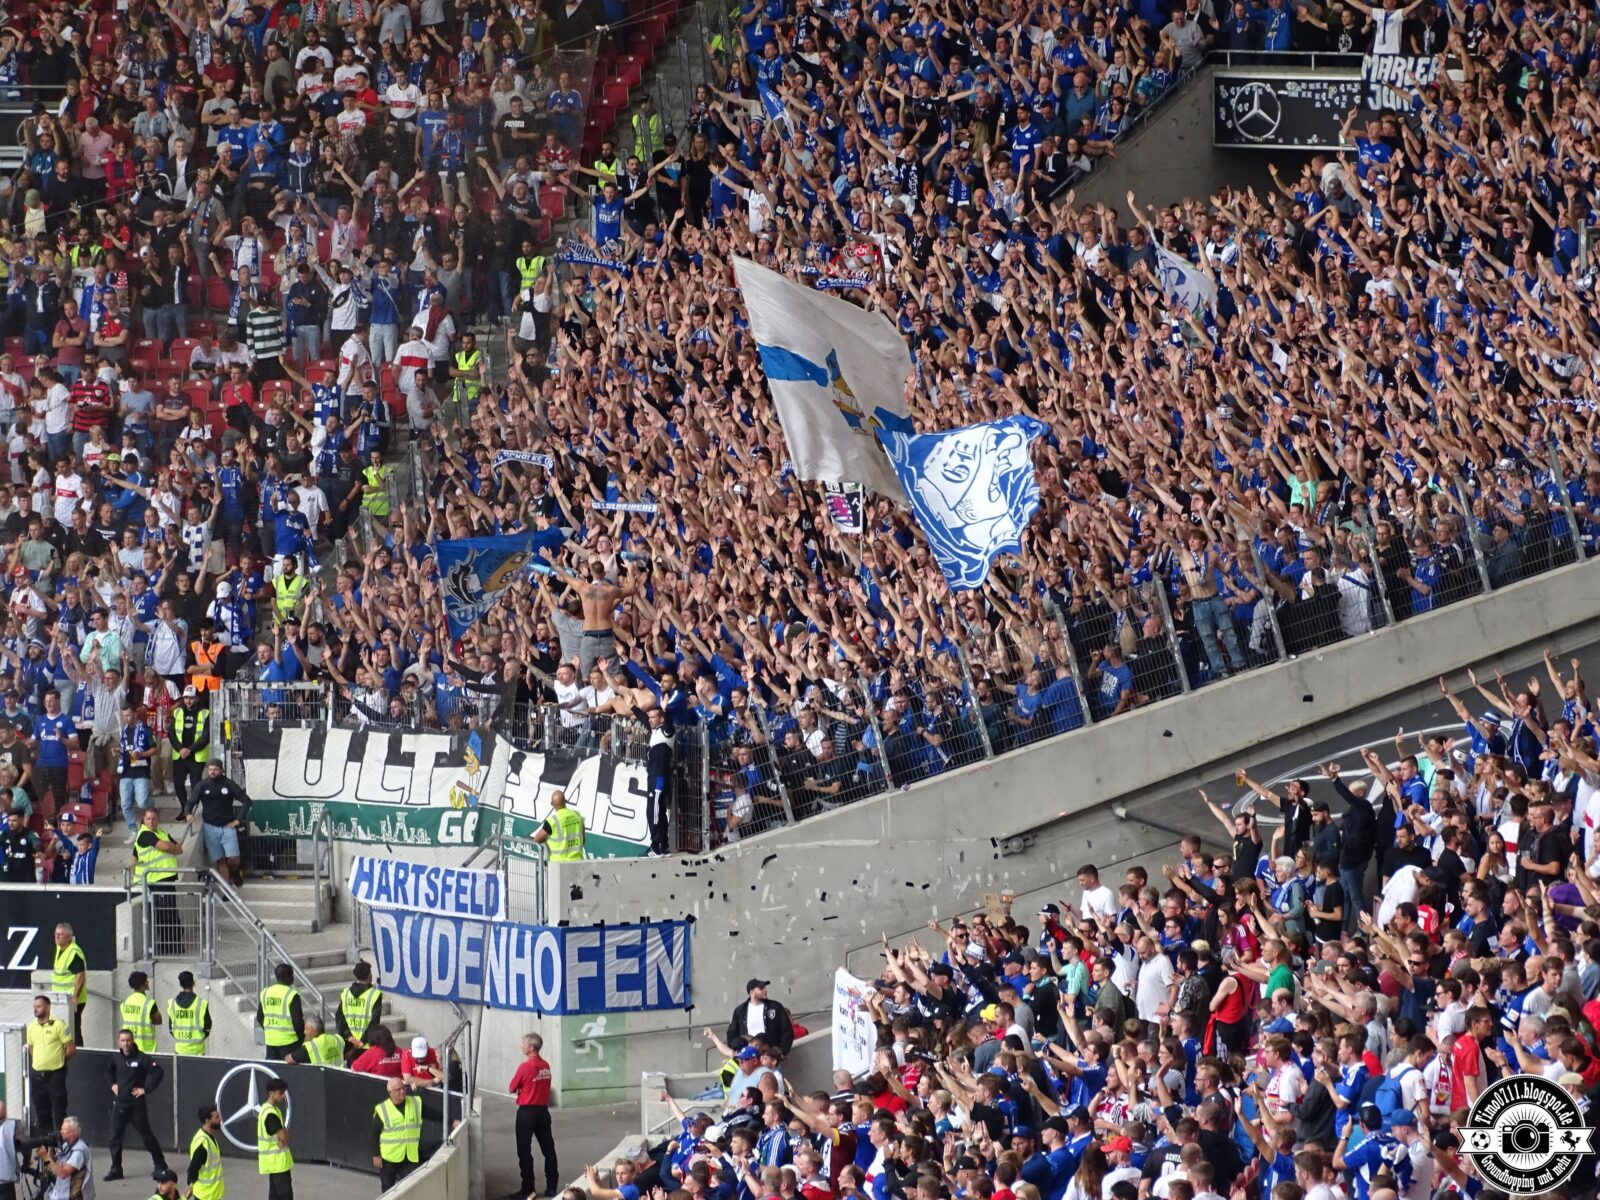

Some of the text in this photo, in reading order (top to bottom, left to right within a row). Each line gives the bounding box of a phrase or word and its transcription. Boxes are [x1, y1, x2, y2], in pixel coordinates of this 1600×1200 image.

[271, 727, 648, 842] ULTRAS
[351, 856, 500, 917] HÄRTSFELD
[372, 908, 685, 1012] DUDENHOFEN
